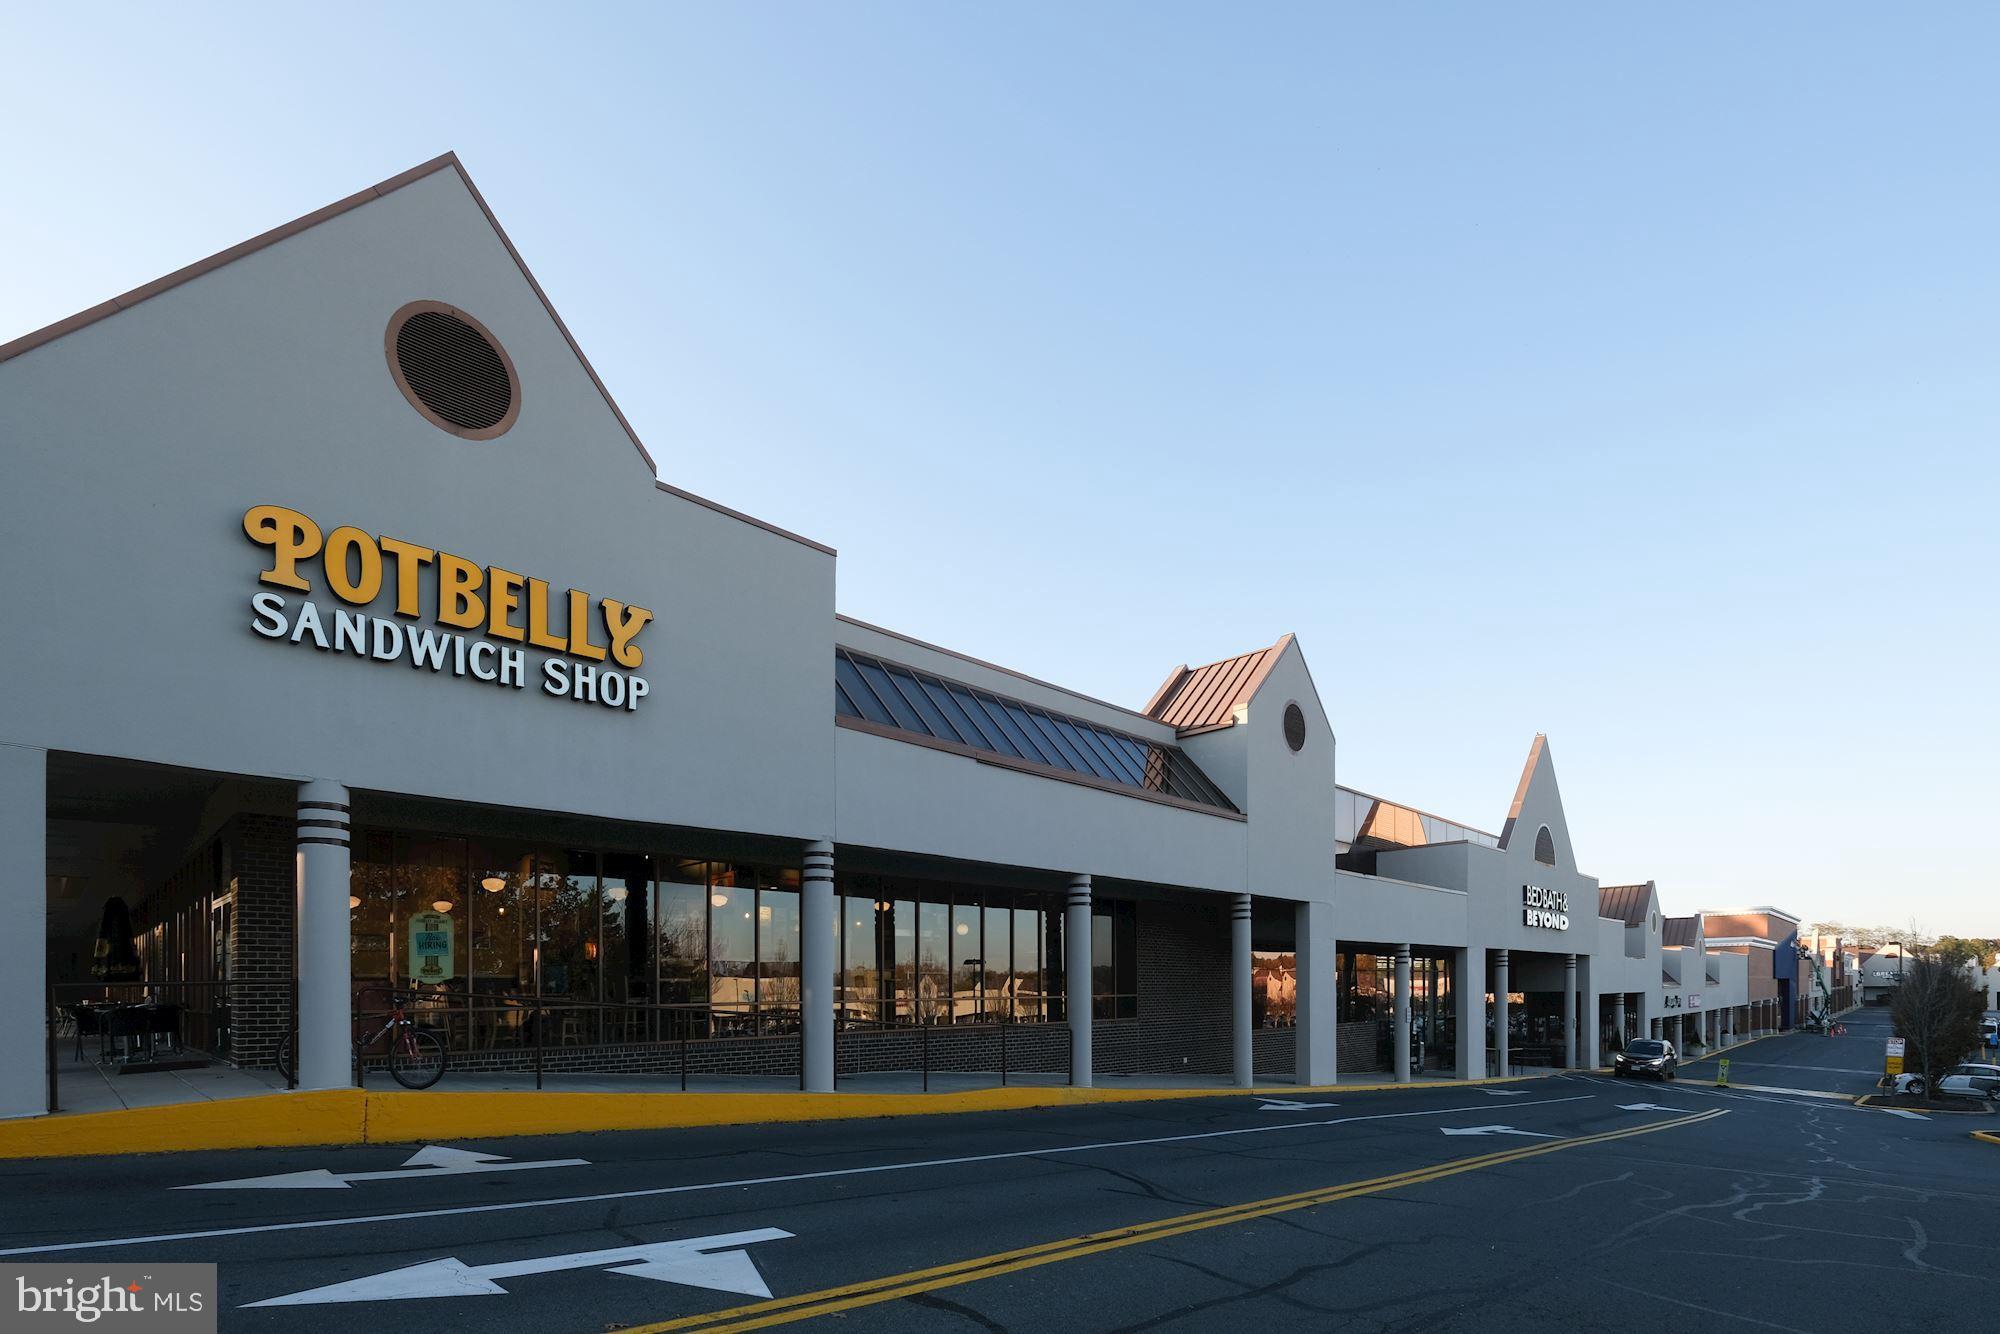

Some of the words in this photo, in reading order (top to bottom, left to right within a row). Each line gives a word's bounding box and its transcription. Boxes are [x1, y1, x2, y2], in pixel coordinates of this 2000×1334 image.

[243, 505, 654, 668] POTBELLY
[251, 592, 526, 689] SANDWICH
[543, 658, 651, 712] SHOP
[1526, 885, 1543, 906] BED
[1543, 889, 1562, 910] BATH
[1563, 893, 1569, 912] &
[1526, 909, 1569, 931] BEYOND
[418, 941, 447, 950] HIRING
